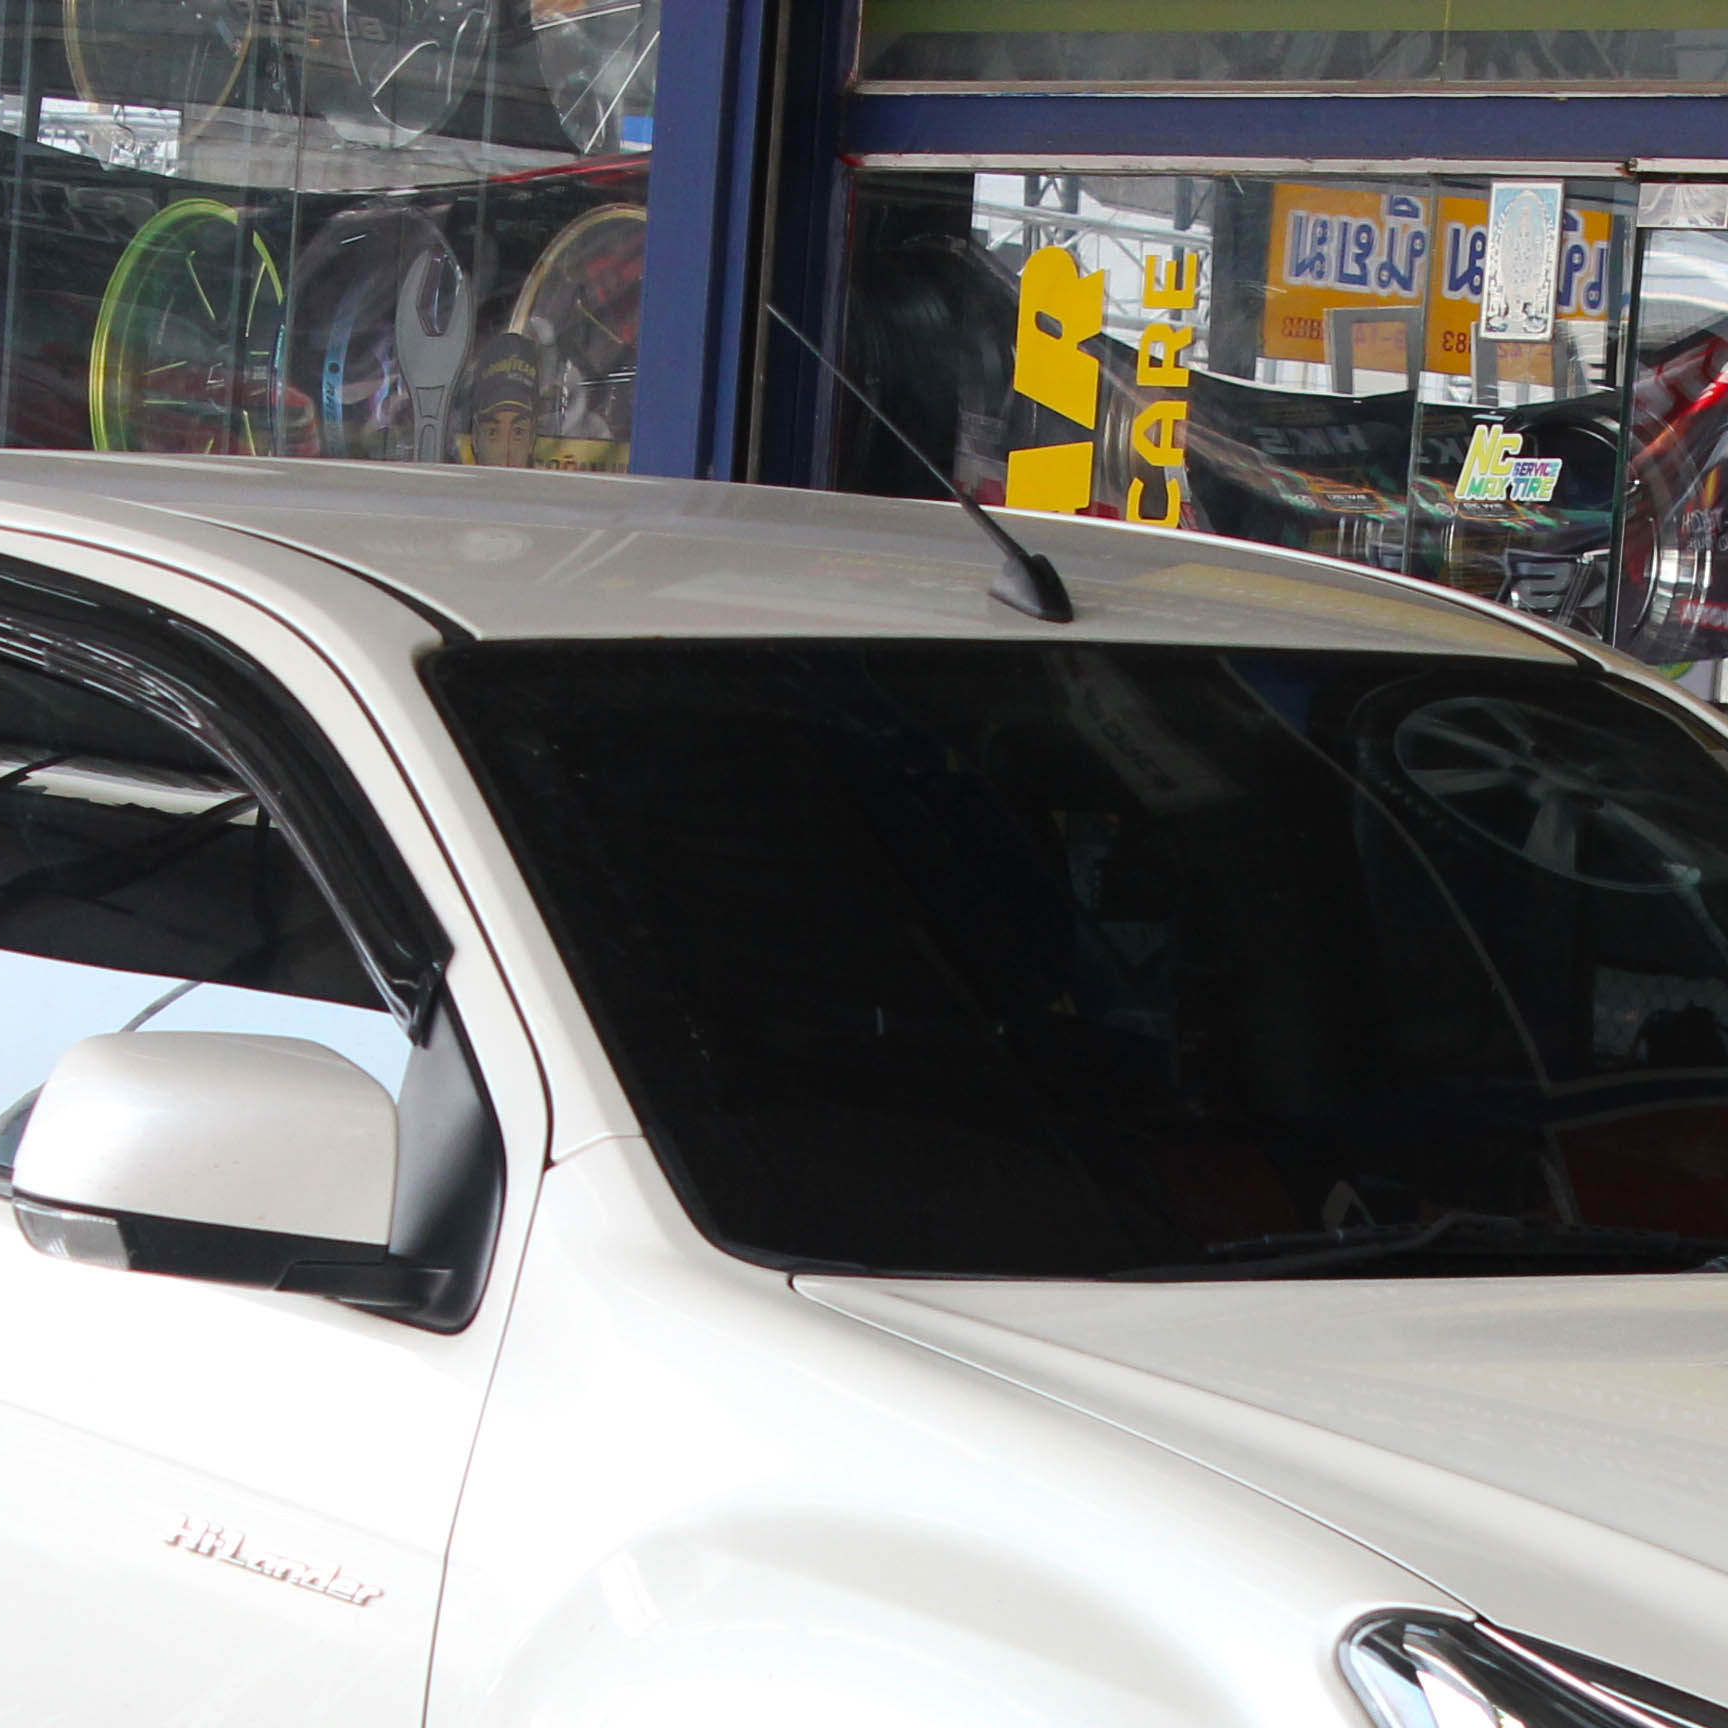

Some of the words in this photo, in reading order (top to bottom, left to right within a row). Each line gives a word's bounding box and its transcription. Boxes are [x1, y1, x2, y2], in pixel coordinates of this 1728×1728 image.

[1457, 427, 1521, 497] NC
[1512, 462, 1560, 477] SERVICE
[1466, 477, 1511, 498] MAX
[1511, 477, 1555, 499] TIRE
